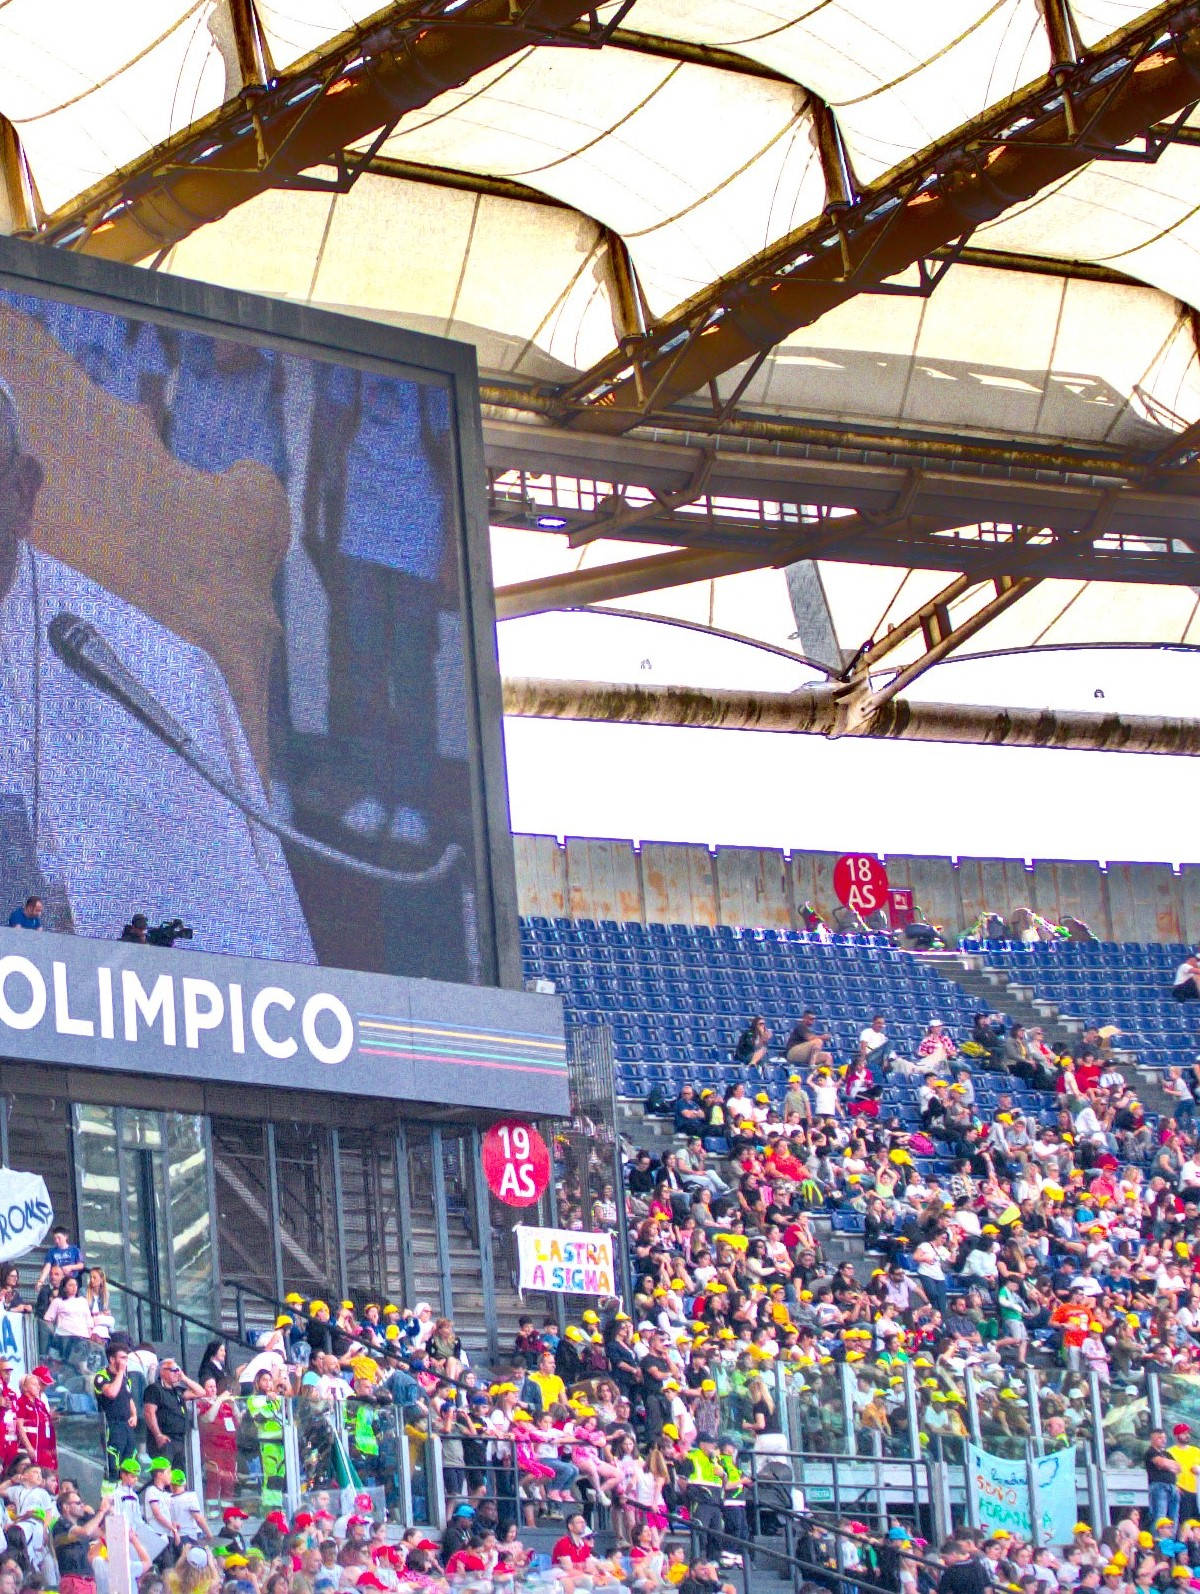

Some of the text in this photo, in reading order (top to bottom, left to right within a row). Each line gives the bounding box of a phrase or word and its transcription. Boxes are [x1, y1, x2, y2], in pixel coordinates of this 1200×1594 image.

[846, 858, 872, 882] 18
[848, 884, 876, 909] AS
[498, 1126, 531, 1161] 19
[500, 1162, 537, 1198] AS
[534, 1239, 610, 1266] LASTRA
[532, 1265, 546, 1286] A
